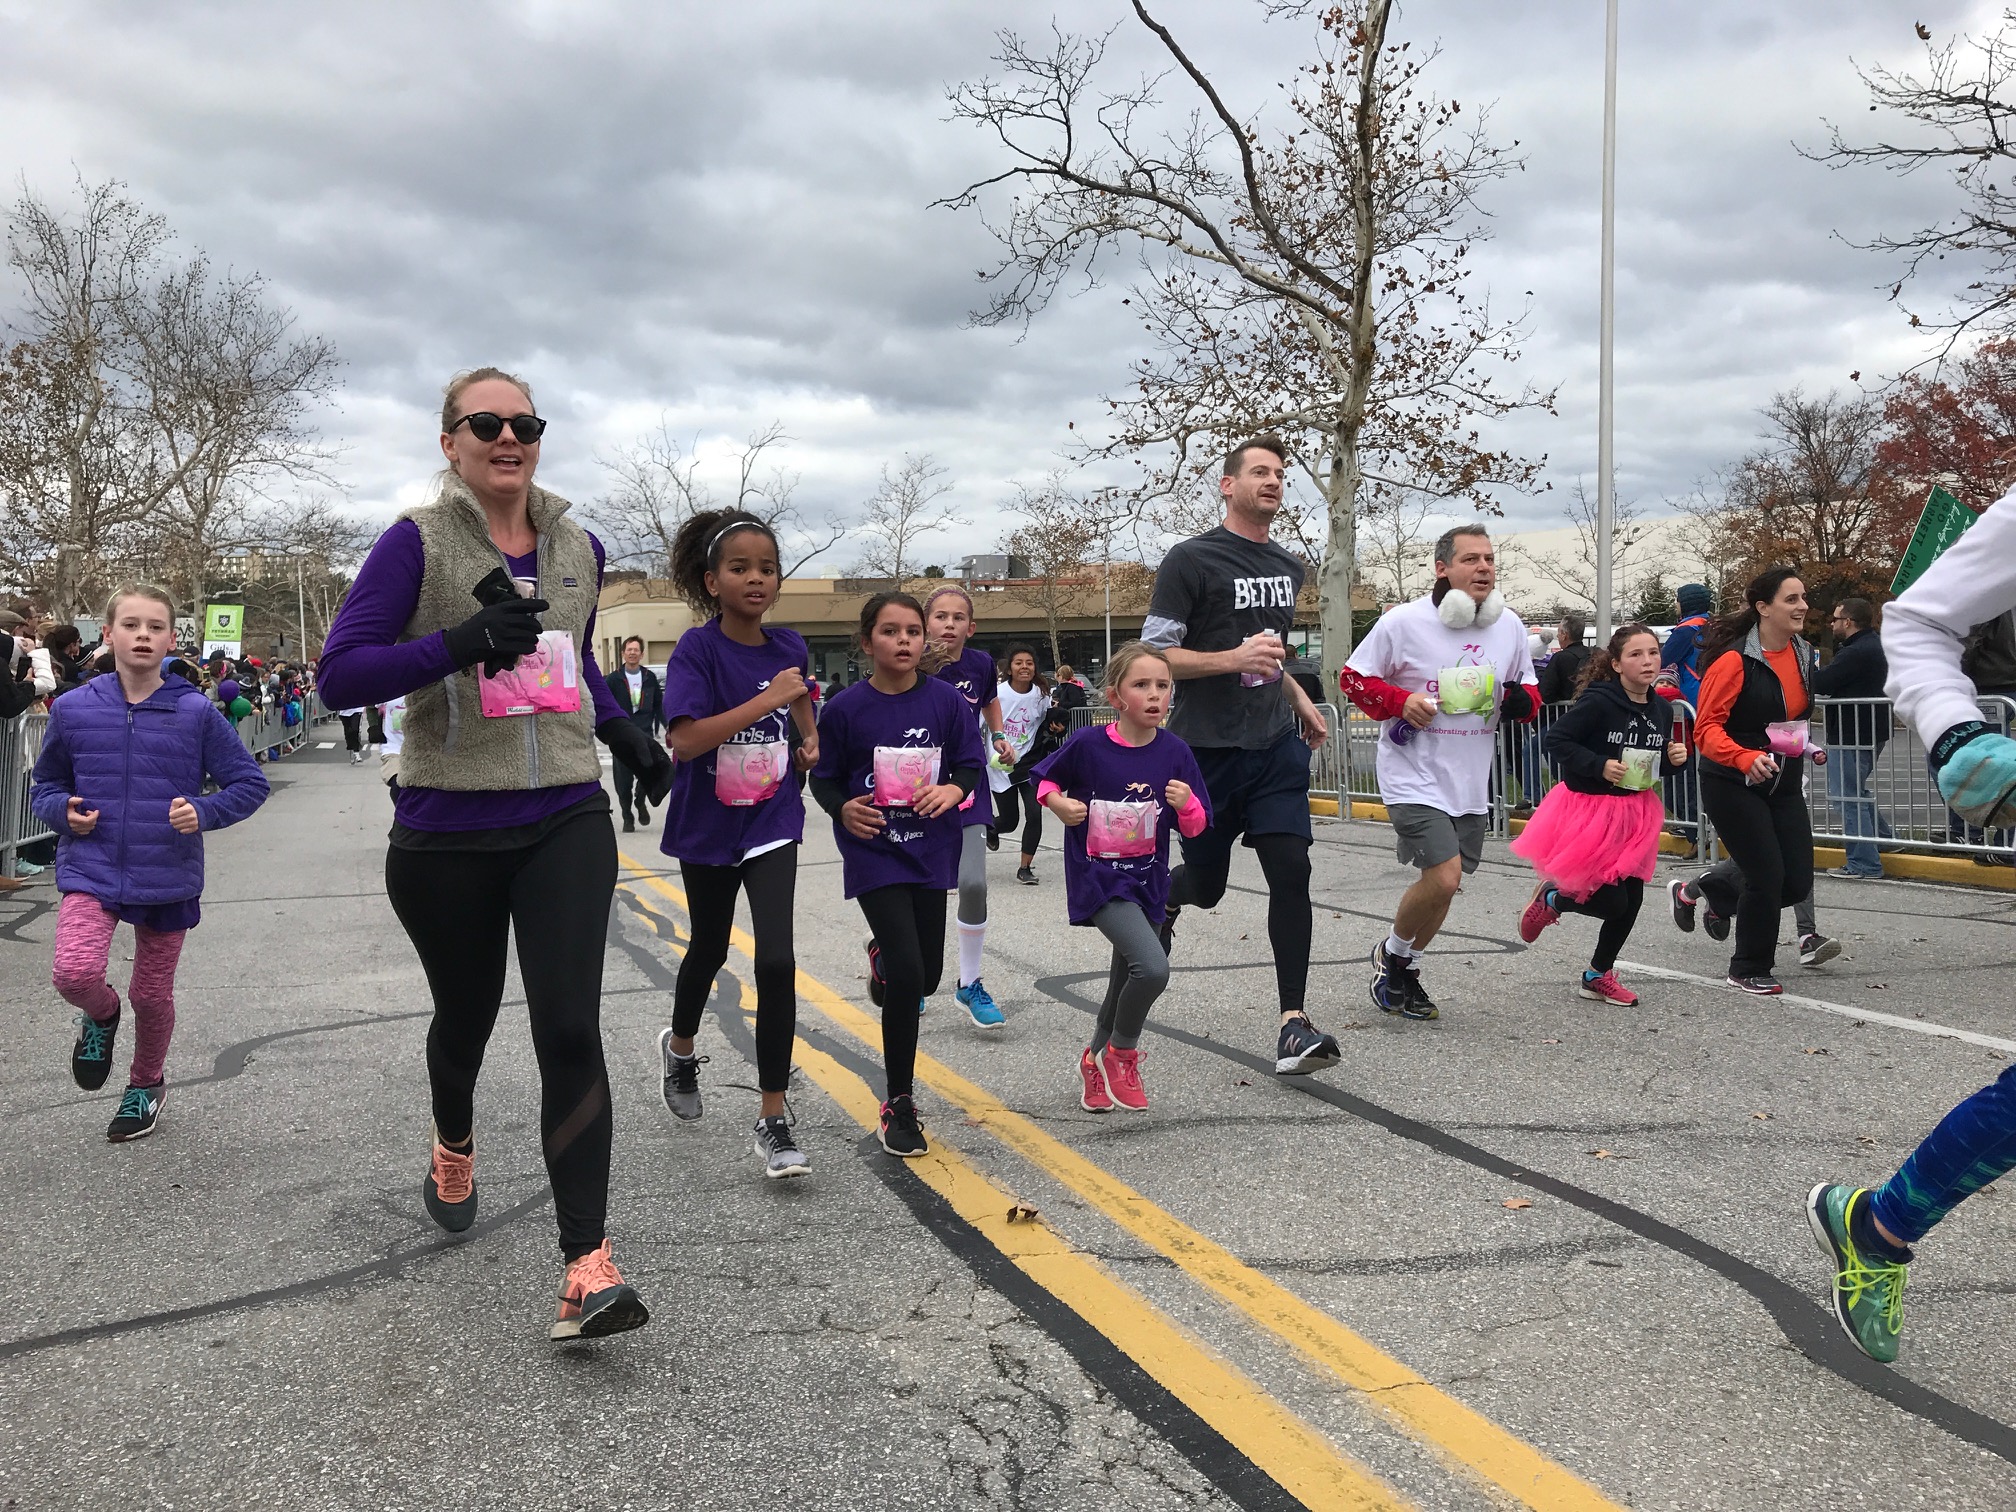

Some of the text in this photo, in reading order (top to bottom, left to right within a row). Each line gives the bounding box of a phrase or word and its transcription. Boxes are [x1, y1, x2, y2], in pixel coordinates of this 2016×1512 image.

[1915, 490, 1944, 547] GARRETT
[1937, 502, 1950, 523] GO
[1897, 552, 1917, 588] PARK
[1234, 575, 1294, 610] BETTER
[726, 727, 775, 744] irls on
[1423, 726, 1468, 736] Celebrating
[896, 811, 913, 819] Cigna
